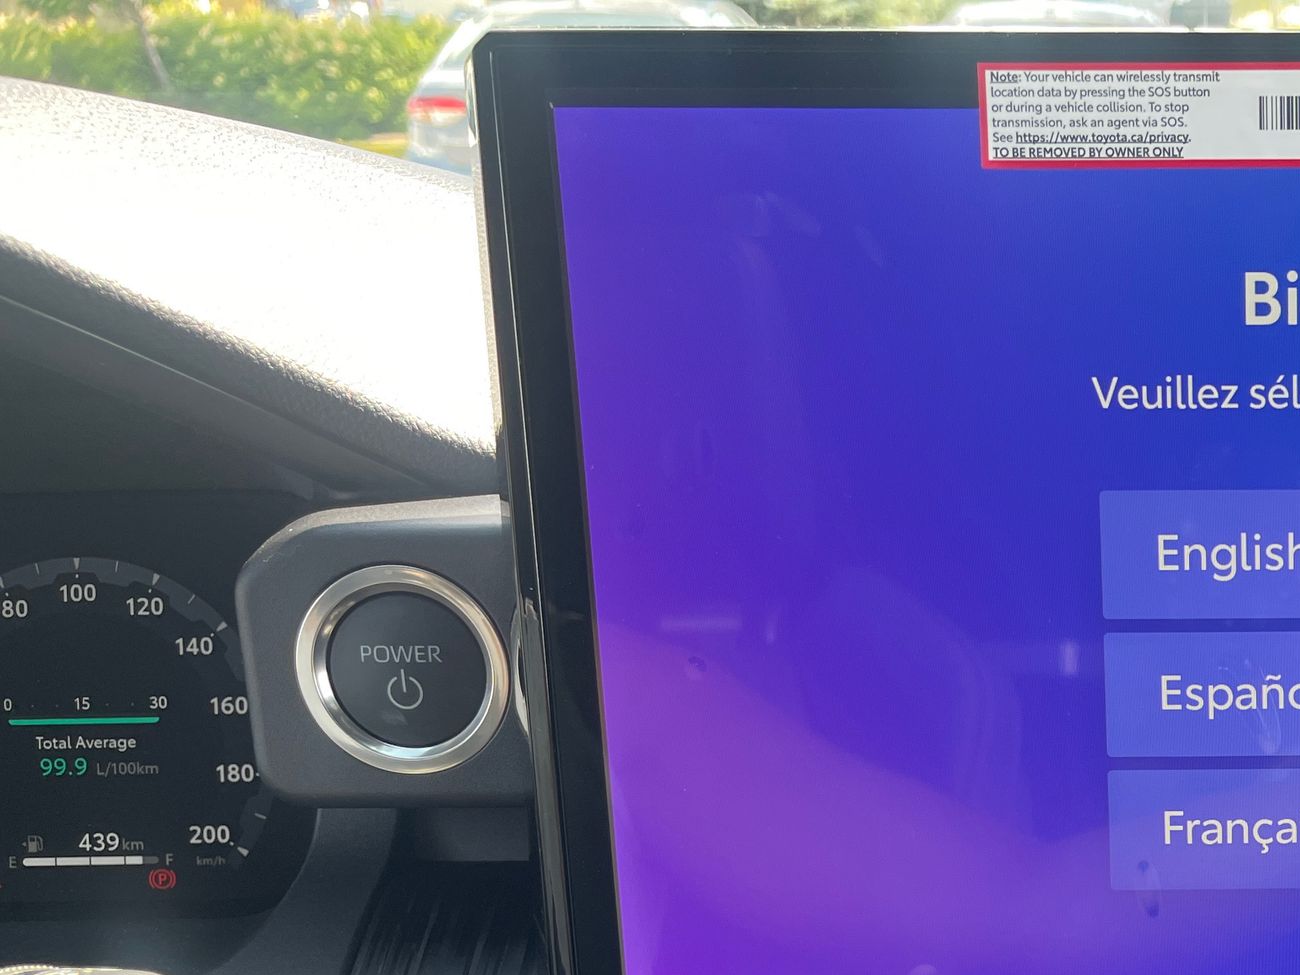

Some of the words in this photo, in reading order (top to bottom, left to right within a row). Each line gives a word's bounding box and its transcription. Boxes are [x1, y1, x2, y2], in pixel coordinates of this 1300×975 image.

[990, 72, 1021, 83] Note:
[1024, 72, 1049, 82] Your
[1052, 72, 1091, 82] vehicle
[1094, 74, 1114, 82] can
[1116, 72, 1170, 84] wirelessly
[1173, 72, 1219, 82] transmit
[991, 87, 1034, 98] location
[1037, 87, 1061, 97] data
[1064, 87, 1077, 99] by
[1080, 88, 1125, 99] pressing
[1128, 87, 1145, 97] the
[1148, 87, 1170, 97] SOS
[1174, 87, 1210, 97] button
[992, 104, 1003, 112] or
[1006, 102, 1042, 114] during
[1045, 104, 1051, 112] a
[1055, 102, 1093, 112] vehicle
[1096, 102, 1146, 112] collision.
[1150, 103, 1161, 112] To
[1164, 103, 1189, 114] stop
[992, 118, 1066, 129] transmission,
[1069, 117, 1087, 127] ask
[1091, 119, 1104, 127] an
[1107, 119, 1139, 129] agent
[1142, 117, 1157, 127] via
[1160, 117, 1187, 127] SOS.
[993, 133, 1013, 142] See
[1016, 132, 1191, 144] https://www.toyota.ca/privacy.
[993, 148, 1009, 158] TO
[1012, 148, 1026, 158] BE
[1029, 148, 1085, 158] REMOVED
[1088, 148, 1102, 158] BY
[1105, 148, 1150, 158] OWNER
[1152, 148, 1184, 158] ONLY
[1092, 376, 1239, 408] Veuillez
[59, 584, 96, 602] 100
[1, 600, 28, 618] 80
[126, 598, 163, 616] 120
[175, 637, 213, 656] 140
[360, 645, 442, 663] POWER
[3, 699, 13, 712] 0
[74, 697, 90, 711] 15
[149, 696, 167, 710] 30
[210, 697, 248, 715] 160
[36, 737, 72, 750] Total
[76, 737, 137, 752] Average
[40, 758, 88, 776] 99.9
[97, 761, 159, 776] L/100km
[216, 764, 254, 783] 180
[79, 833, 120, 851] 439
[123, 838, 144, 850] km
[189, 826, 230, 844] 200
[9, 856, 17, 868] E
[166, 853, 173, 865] F
[196, 855, 226, 867] km/h
